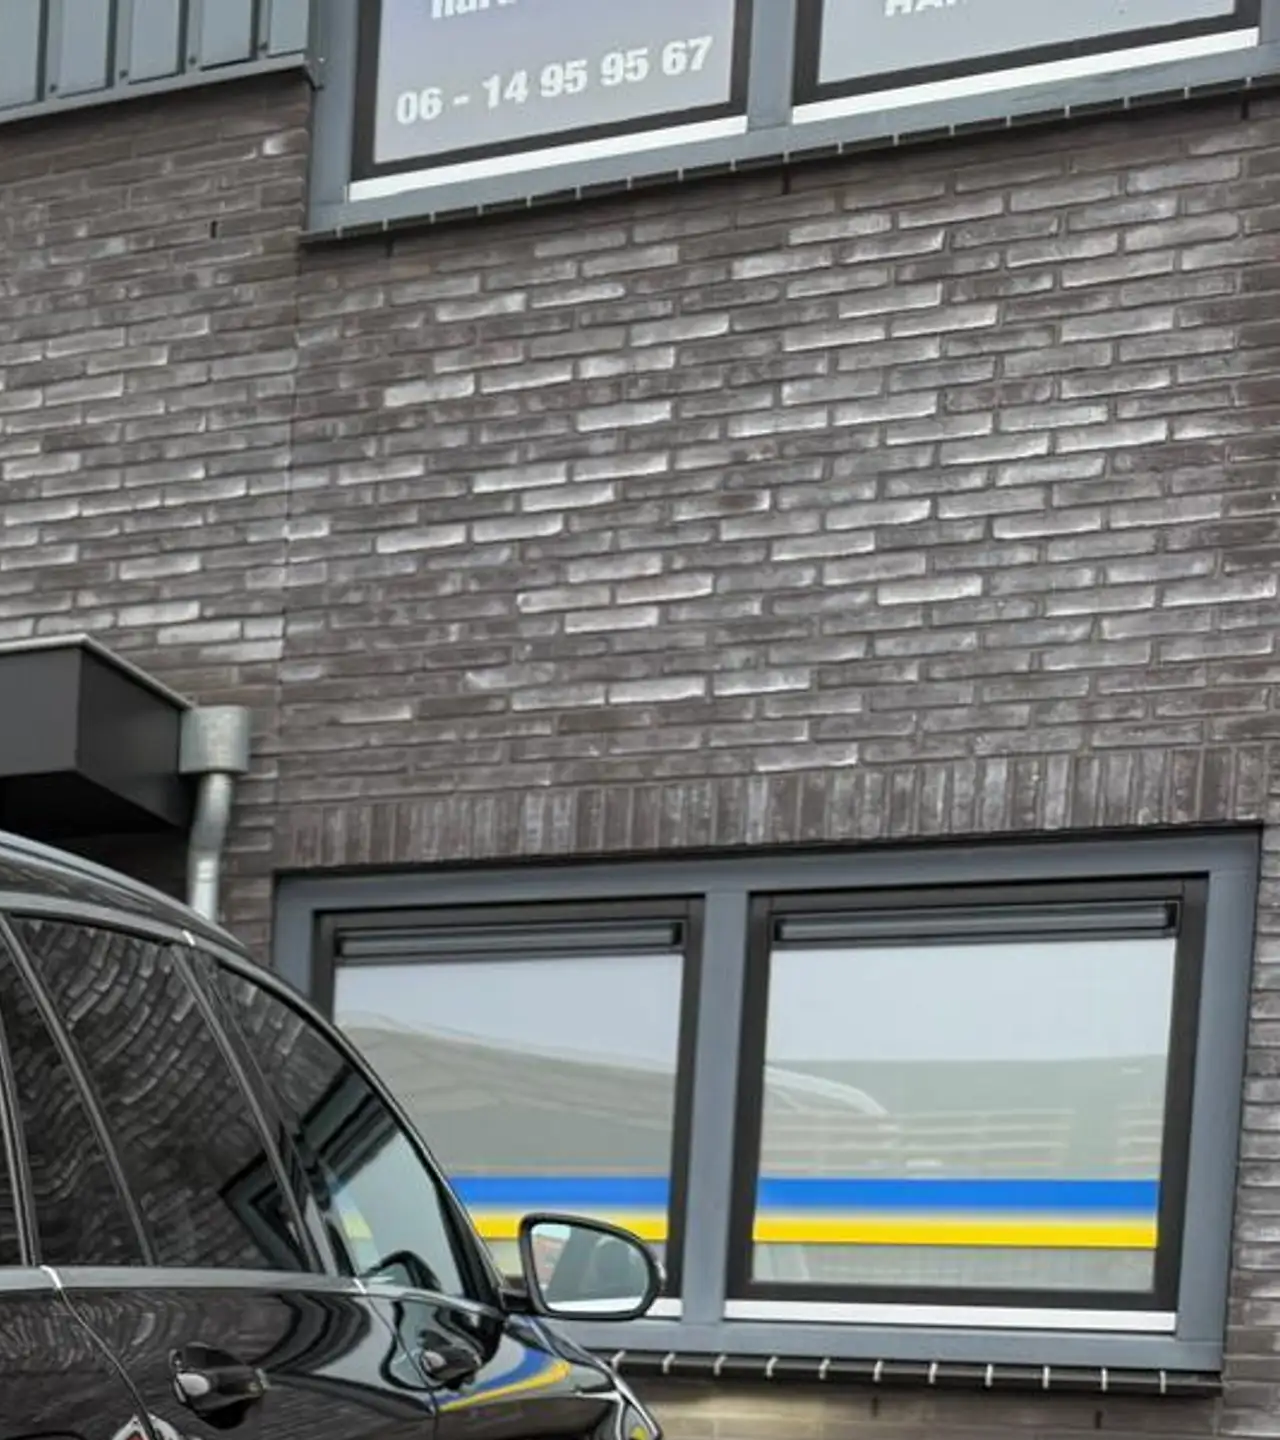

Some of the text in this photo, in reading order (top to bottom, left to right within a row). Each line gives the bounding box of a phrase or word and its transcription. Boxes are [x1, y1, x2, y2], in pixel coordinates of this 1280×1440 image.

[396, 87, 443, 125] 06
[481, 69, 529, 109] 14
[540, 59, 589, 98] 95
[600, 47, 649, 87] 95
[662, 35, 713, 76] 67
